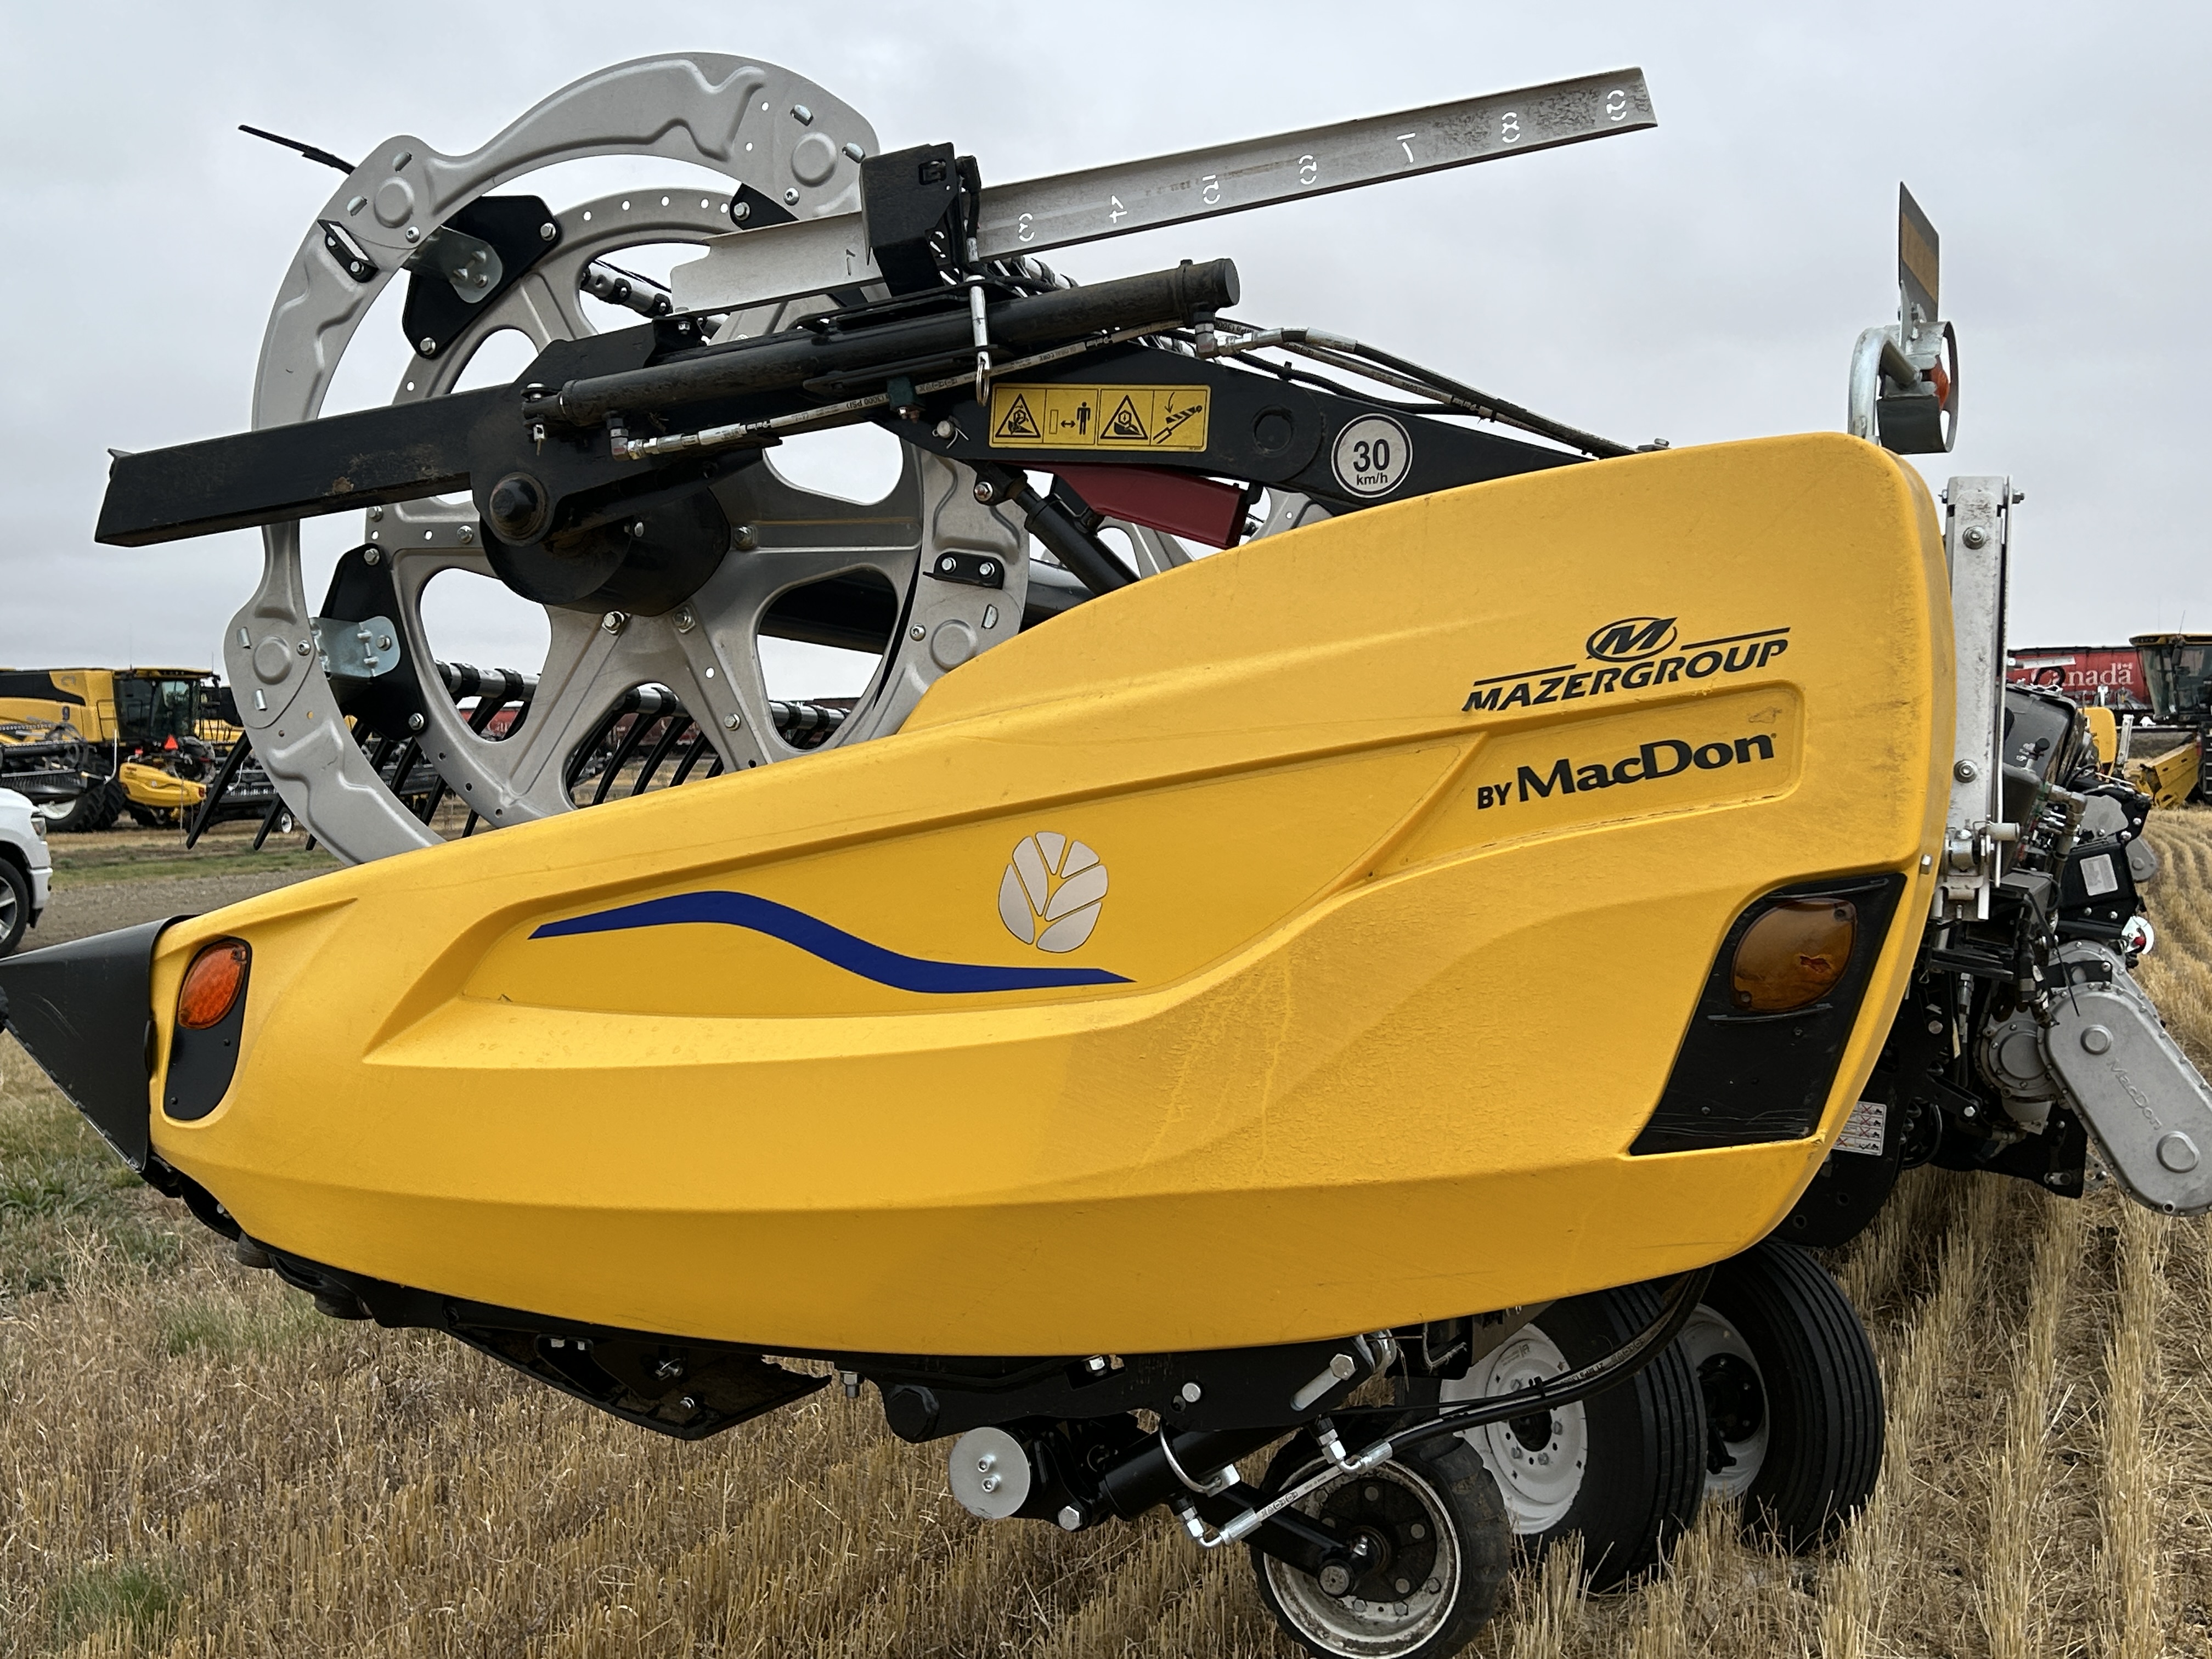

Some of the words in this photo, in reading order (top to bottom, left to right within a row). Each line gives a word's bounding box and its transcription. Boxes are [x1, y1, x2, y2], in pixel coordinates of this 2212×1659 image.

[1353, 439, 1390, 472] 30
[1356, 472, 1389, 486] km/h
[1461, 639, 1789, 712] MAZERGROUP
[1477, 782, 1513, 810] BY
[1517, 733, 1775, 802] MacDon
[2107, 1058, 2162, 1130] MacDon
